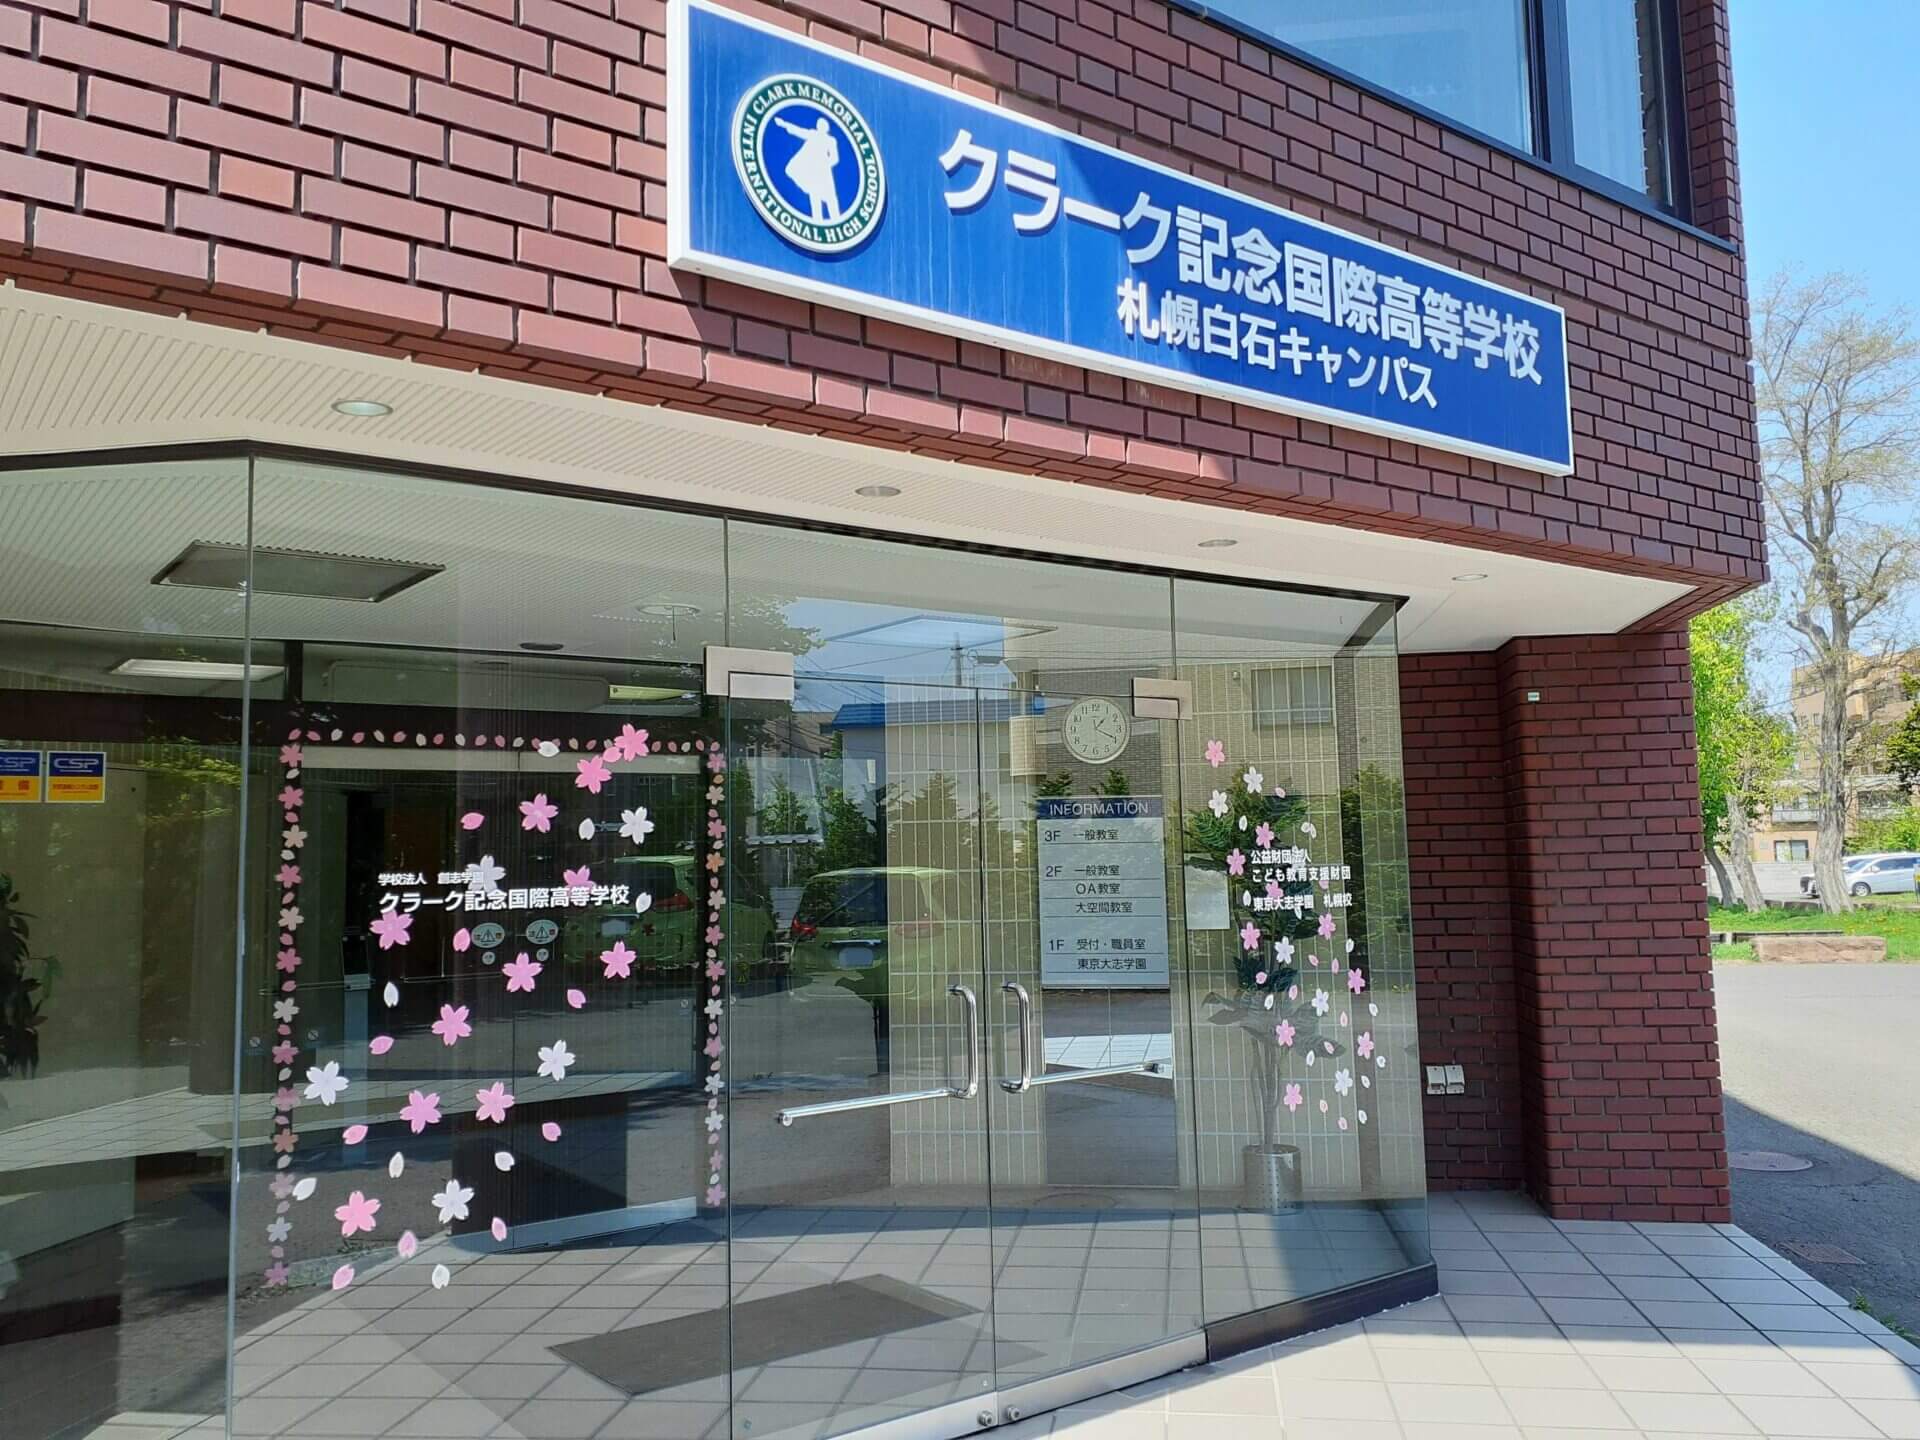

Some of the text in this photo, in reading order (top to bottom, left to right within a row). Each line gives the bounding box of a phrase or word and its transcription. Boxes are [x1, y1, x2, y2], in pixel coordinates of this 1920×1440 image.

[752, 81, 873, 155] CLARK MEMORIAL
[741, 113, 878, 242] INTERNATIONAL HIGH SCHOOL
[939, 130, 1542, 386] クラーク記念国際高等学校
[1117, 278, 1438, 409] 札幌白石キャンパス
[0, 756, 36, 768] SP
[1049, 802, 1149, 816] INFORMATION
[1044, 829, 1120, 842] 3F 一般教室
[1046, 865, 1121, 877] 2F 一般教室
[1075, 883, 1121, 895] OA教室
[379, 885, 629, 913] クラーク記念国際高等学校
[1075, 902, 1133, 914] 大空間教室
[1049, 939, 1065, 951] 1F
